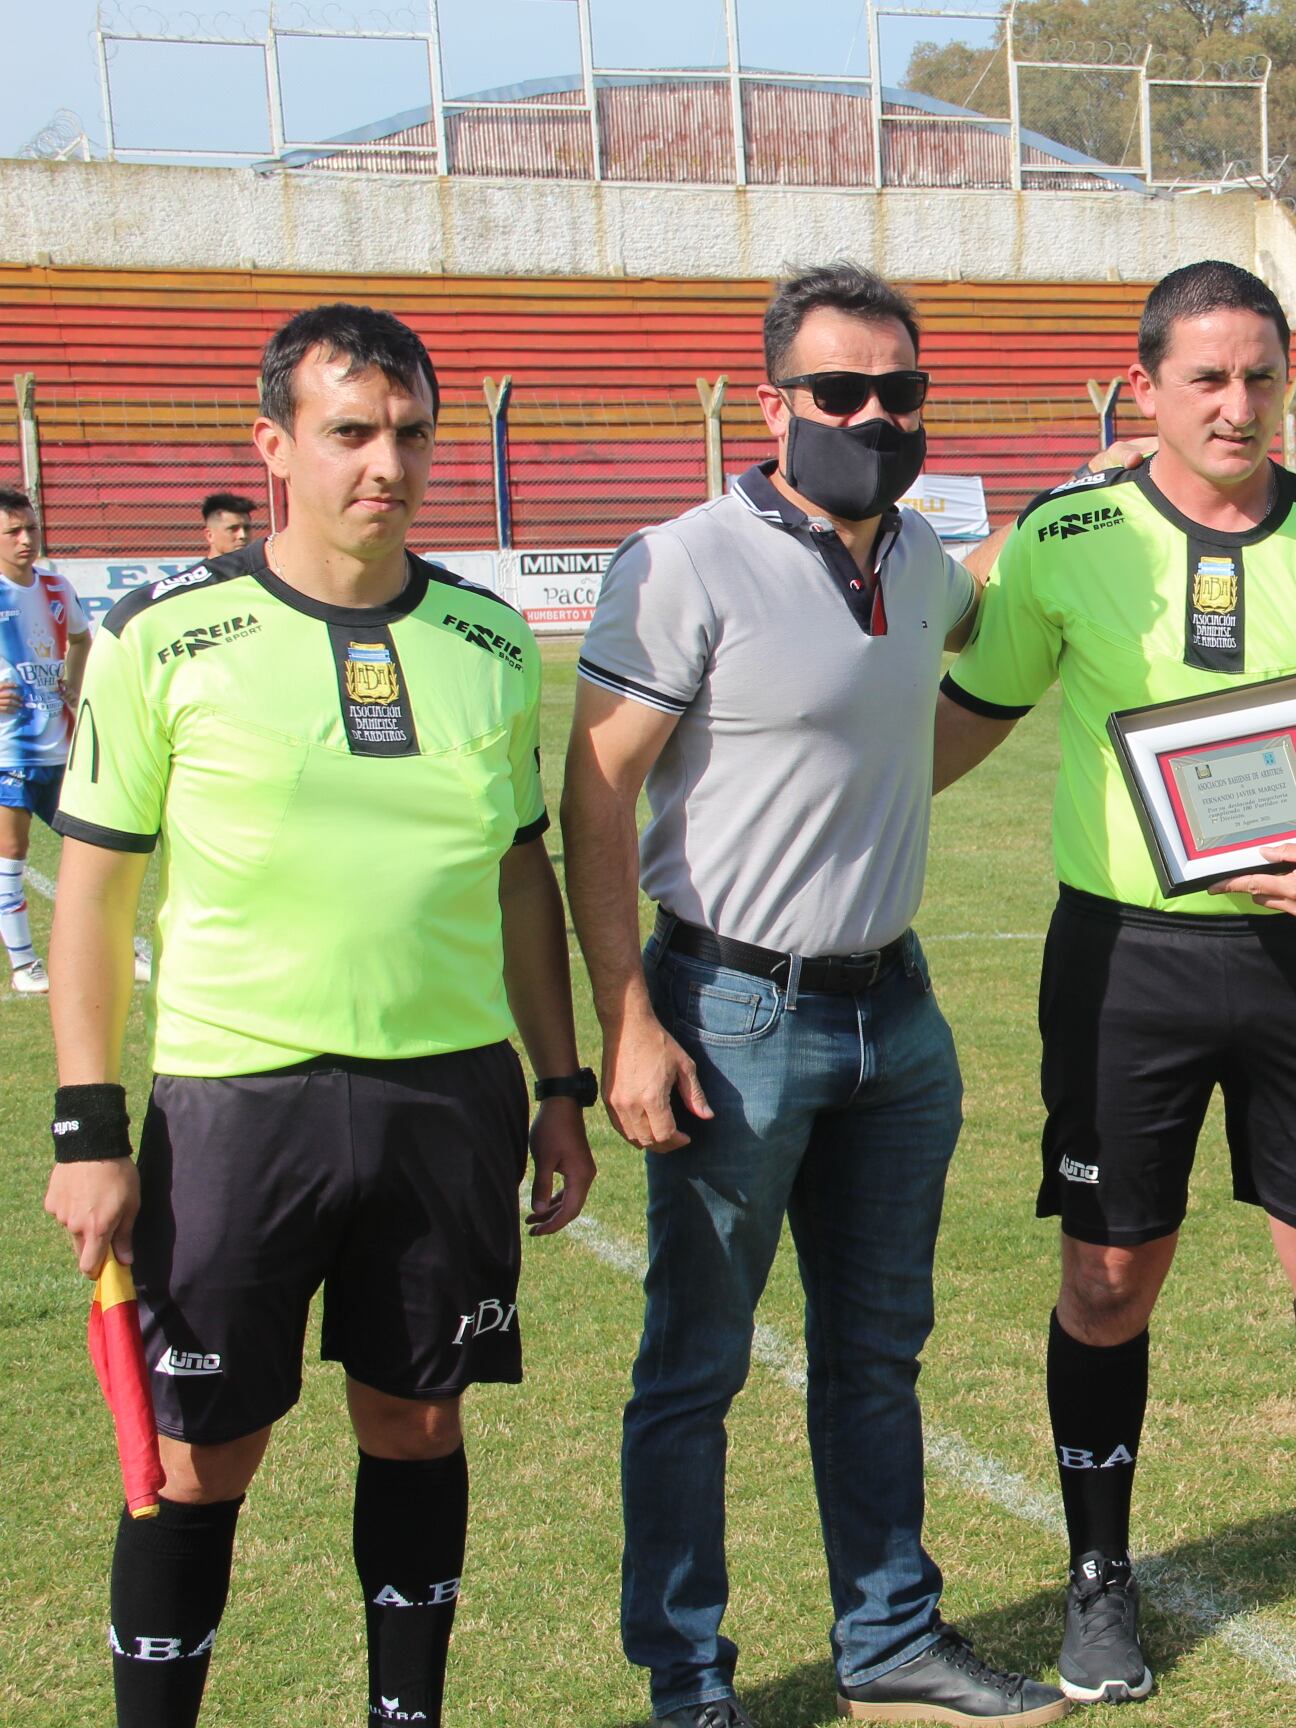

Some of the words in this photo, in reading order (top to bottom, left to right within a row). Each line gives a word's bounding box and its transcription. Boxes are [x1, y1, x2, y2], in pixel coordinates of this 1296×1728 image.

[1093, 517, 1126, 531] SPORT
[527, 610, 580, 621] HUMBERTO
[581, 610, 589, 620] Y
[225, 625, 263, 643] SPORT
[1236, 788, 1256, 798] JAVIER
